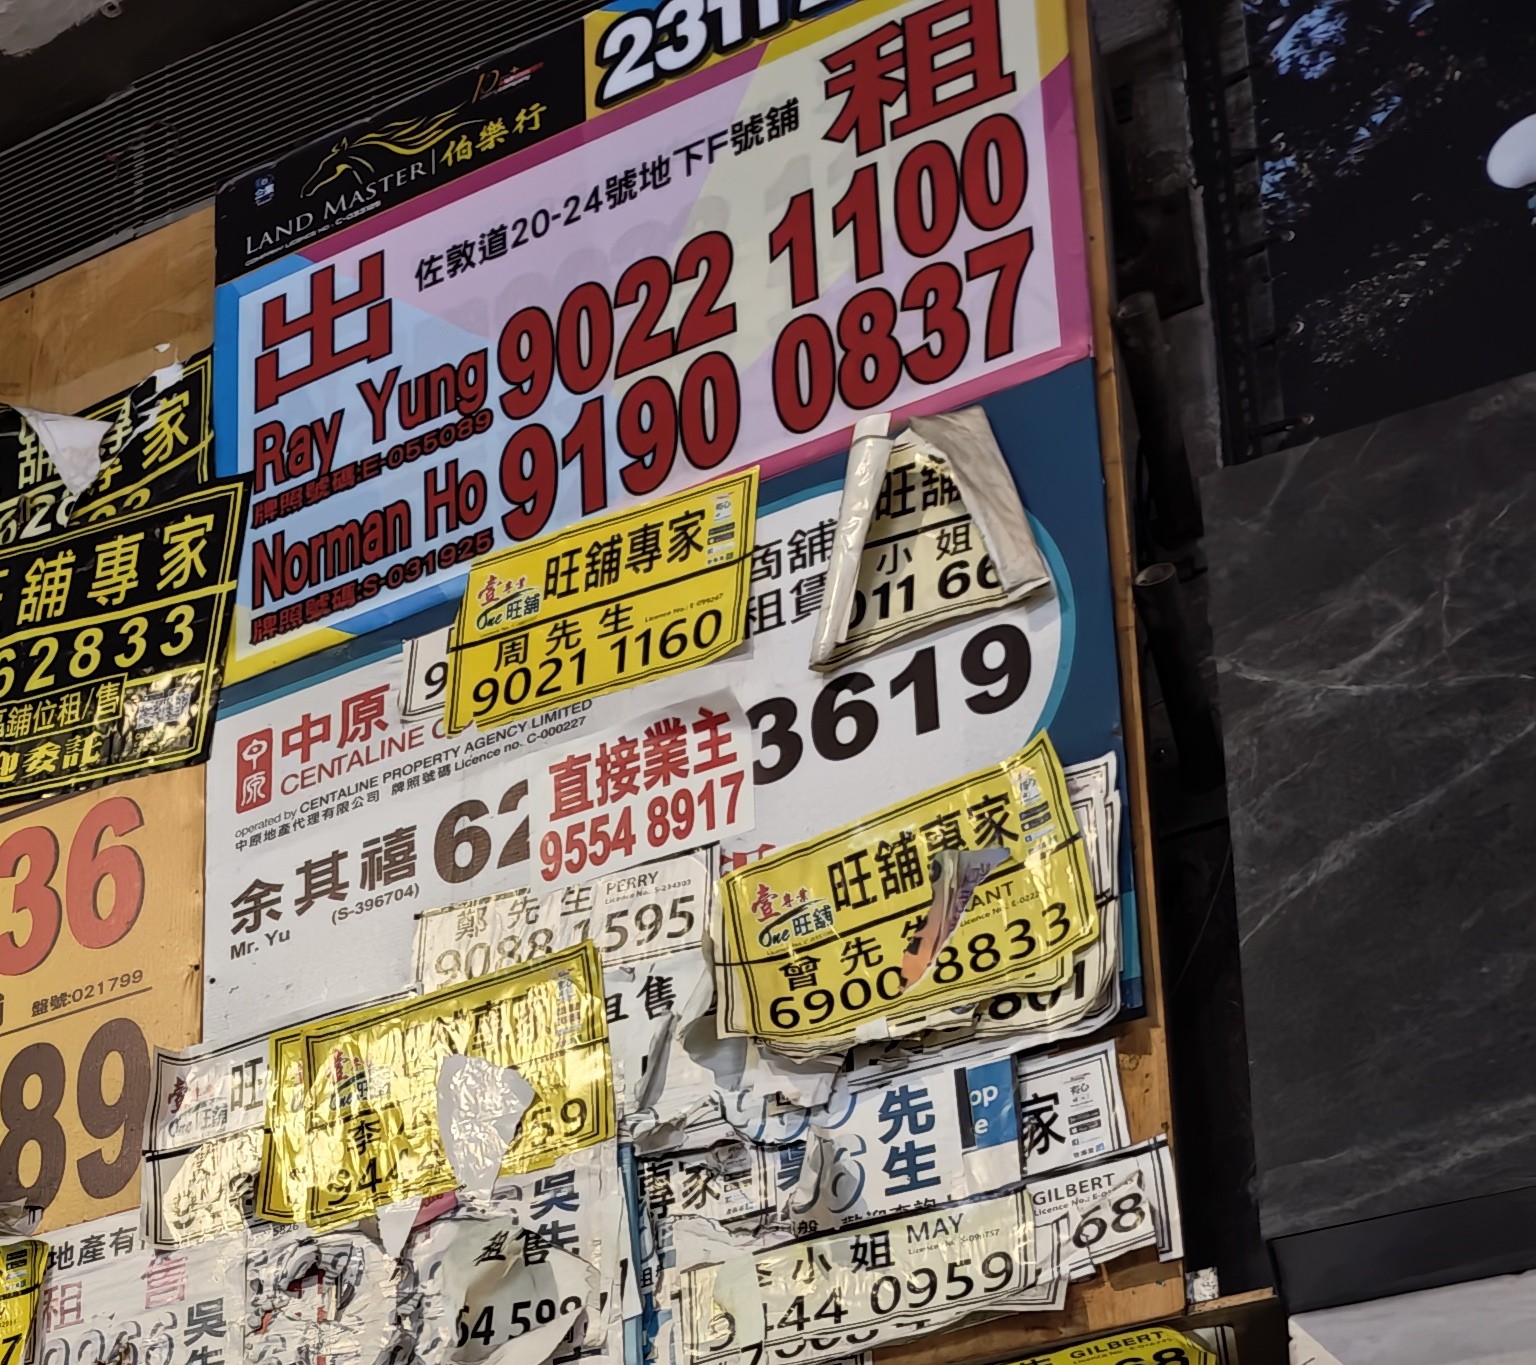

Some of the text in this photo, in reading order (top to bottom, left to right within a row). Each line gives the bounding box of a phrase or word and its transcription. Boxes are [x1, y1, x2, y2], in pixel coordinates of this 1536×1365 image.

[823, 0, 1015, 158] 租
[441, 101, 547, 169] 伯樂行
[244, 213, 311, 254] LAND
[322, 160, 426, 213] MASTER
[413, 98, 800, 293] 佐敦道20-24號地下F號舖
[252, 407, 345, 490] Ray
[359, 348, 487, 441] Yung
[498, 231, 736, 419] 9022
[770, 112, 1027, 307] 1100
[254, 250, 392, 412] 出
[251, 231, 1034, 610] Norman Ho 9190 0837
[472, 608, 721, 716] 9021 1160
[496, 605, 634, 672] 周先生
[280, 683, 391, 763] 中原
[751, 624, 1032, 785] 3619
[234, 700, 592, 838] operated by CENTALINE PROPERTY AGENCY LIMITED
[234, 791, 380, 852] 中原地產代理有限公司
[454, 747, 501, 771] Licence
[504, 741, 525, 753] no.
[527, 717, 587, 745] C-000227
[549, 707, 738, 822] 直接業主
[540, 770, 744, 881] 9554 8917
[230, 826, 417, 936] 余其禧
[331, 883, 419, 925] (S-396704)
[230, 928, 291, 960] Mr. Yu
[906, 1213, 962, 1243] MAY
[872, 1251, 1014, 1317] 0959
[1070, 1327, 1163, 1361] GILBERT
